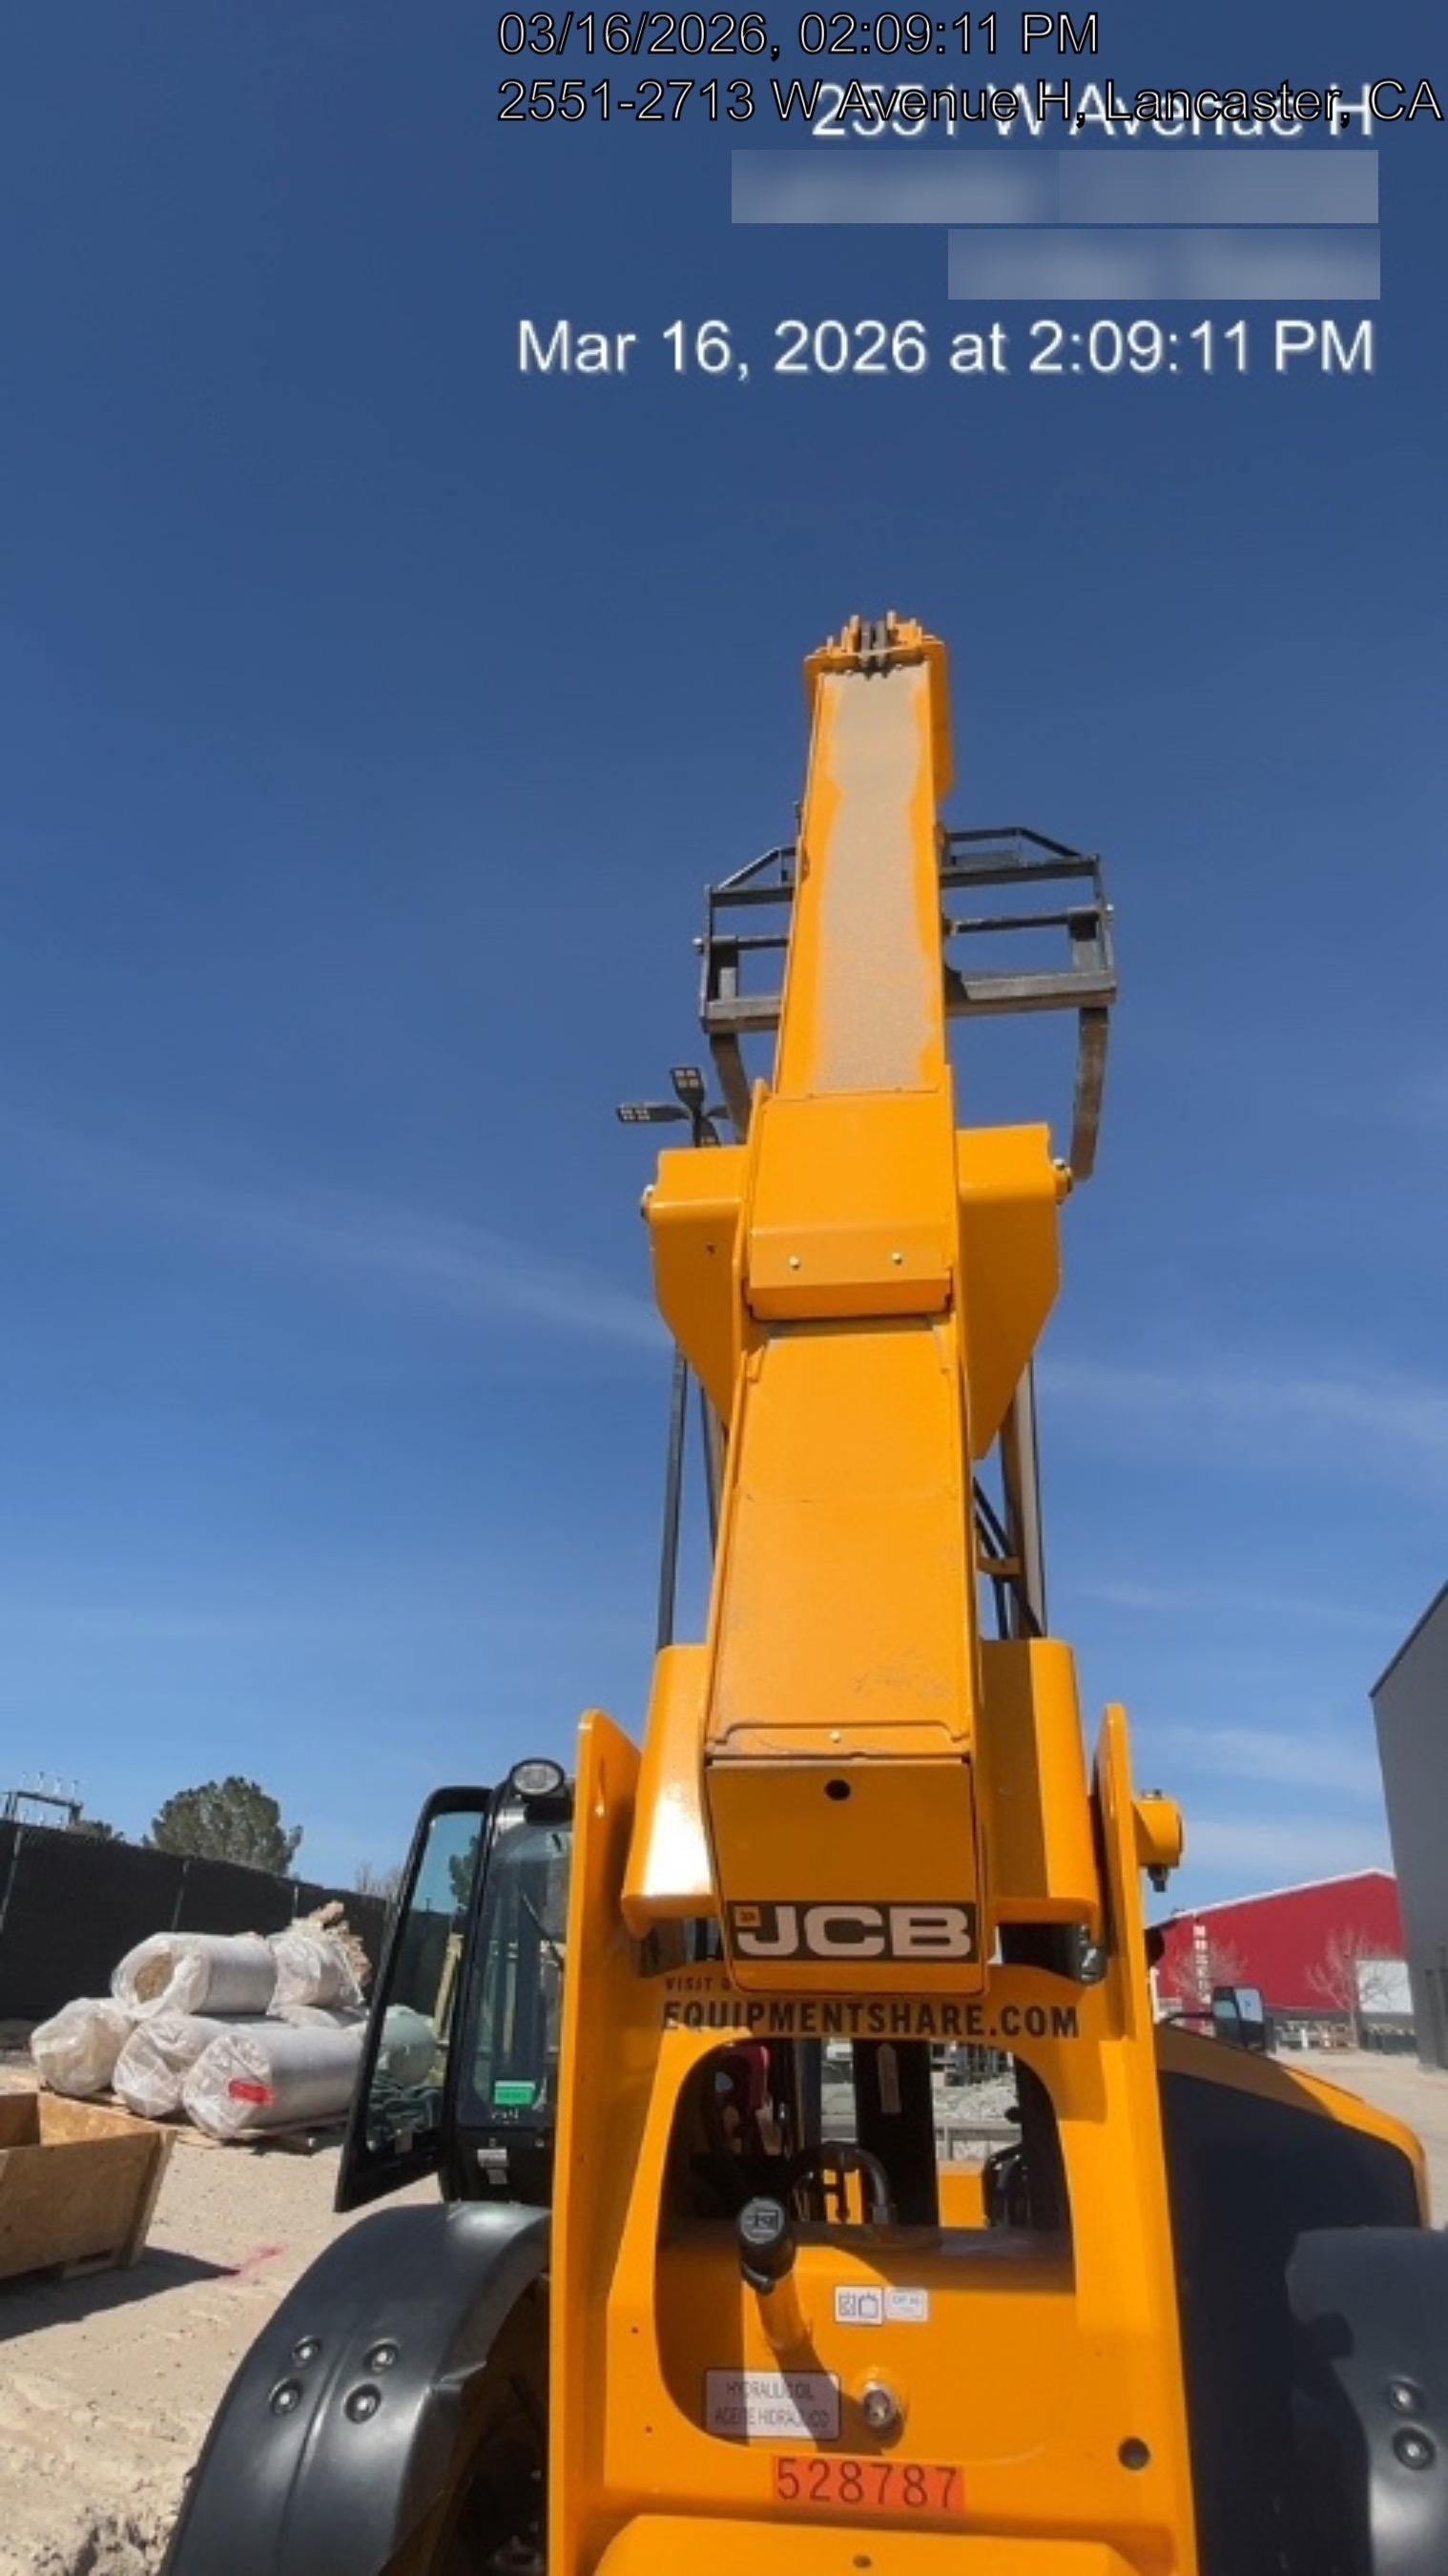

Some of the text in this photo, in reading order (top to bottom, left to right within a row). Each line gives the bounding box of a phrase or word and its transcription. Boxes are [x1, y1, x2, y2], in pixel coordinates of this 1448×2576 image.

[737, 1906, 972, 1957] JCB
[666, 1977, 713, 1991] VISIT
[663, 2001, 1079, 2039] EQUIPMENTSHARE.COM
[776, 2457, 958, 2508] 528787
